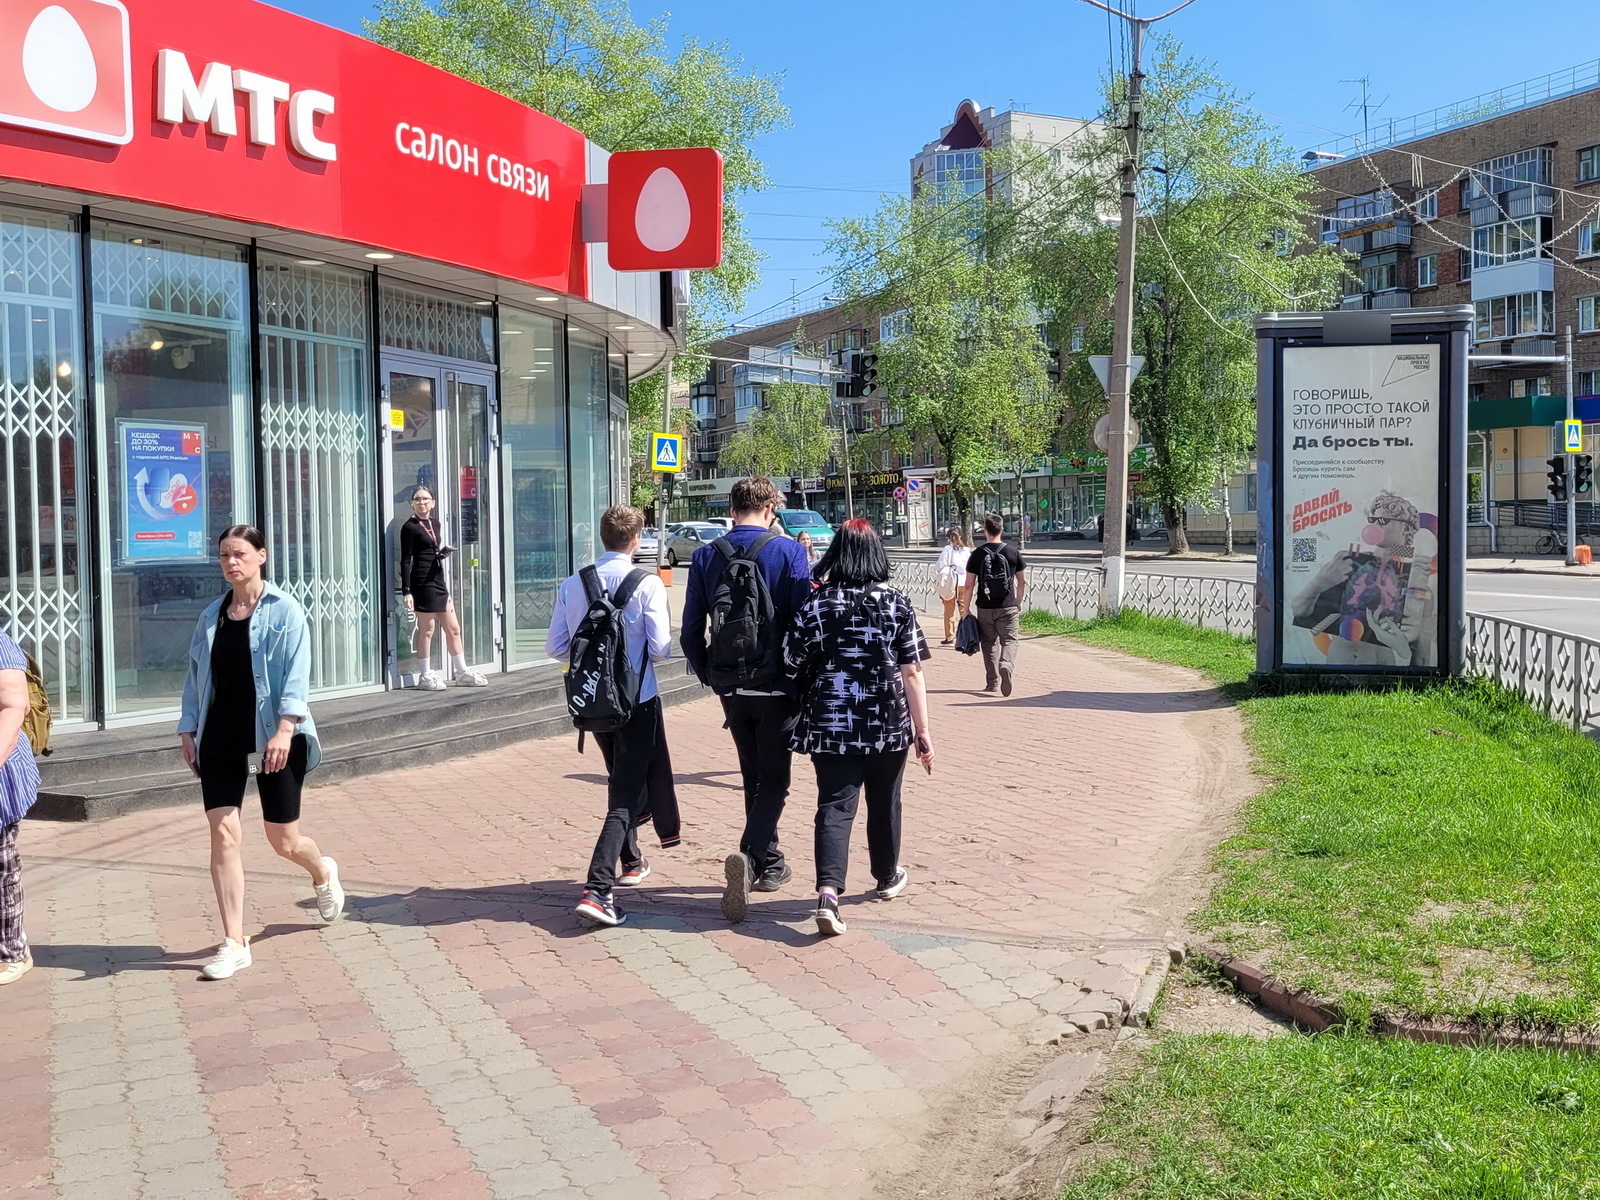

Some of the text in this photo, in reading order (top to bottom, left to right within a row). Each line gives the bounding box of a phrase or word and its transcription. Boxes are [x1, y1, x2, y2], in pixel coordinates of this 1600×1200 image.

[157, 48, 337, 163] МТС
[395, 121, 550, 202] салон связи
[1293, 389, 1373, 401] ГОВОРИШЬ,
[1293, 399, 1430, 416] ЭТО ПРОСТО ТАКОЙ
[1380, 417, 1412, 429] ПАР?
[1293, 435, 1414, 451] Да брось ты.
[1347, 458, 1387, 466] сообществу.
[869, 473, 899, 486] ЗОЛОТО
[164, 479, 181, 501] SHOP
[1292, 487, 1340, 521] ДАВАЙ
[1292, 502, 1353, 533] БРОСАТЬ
